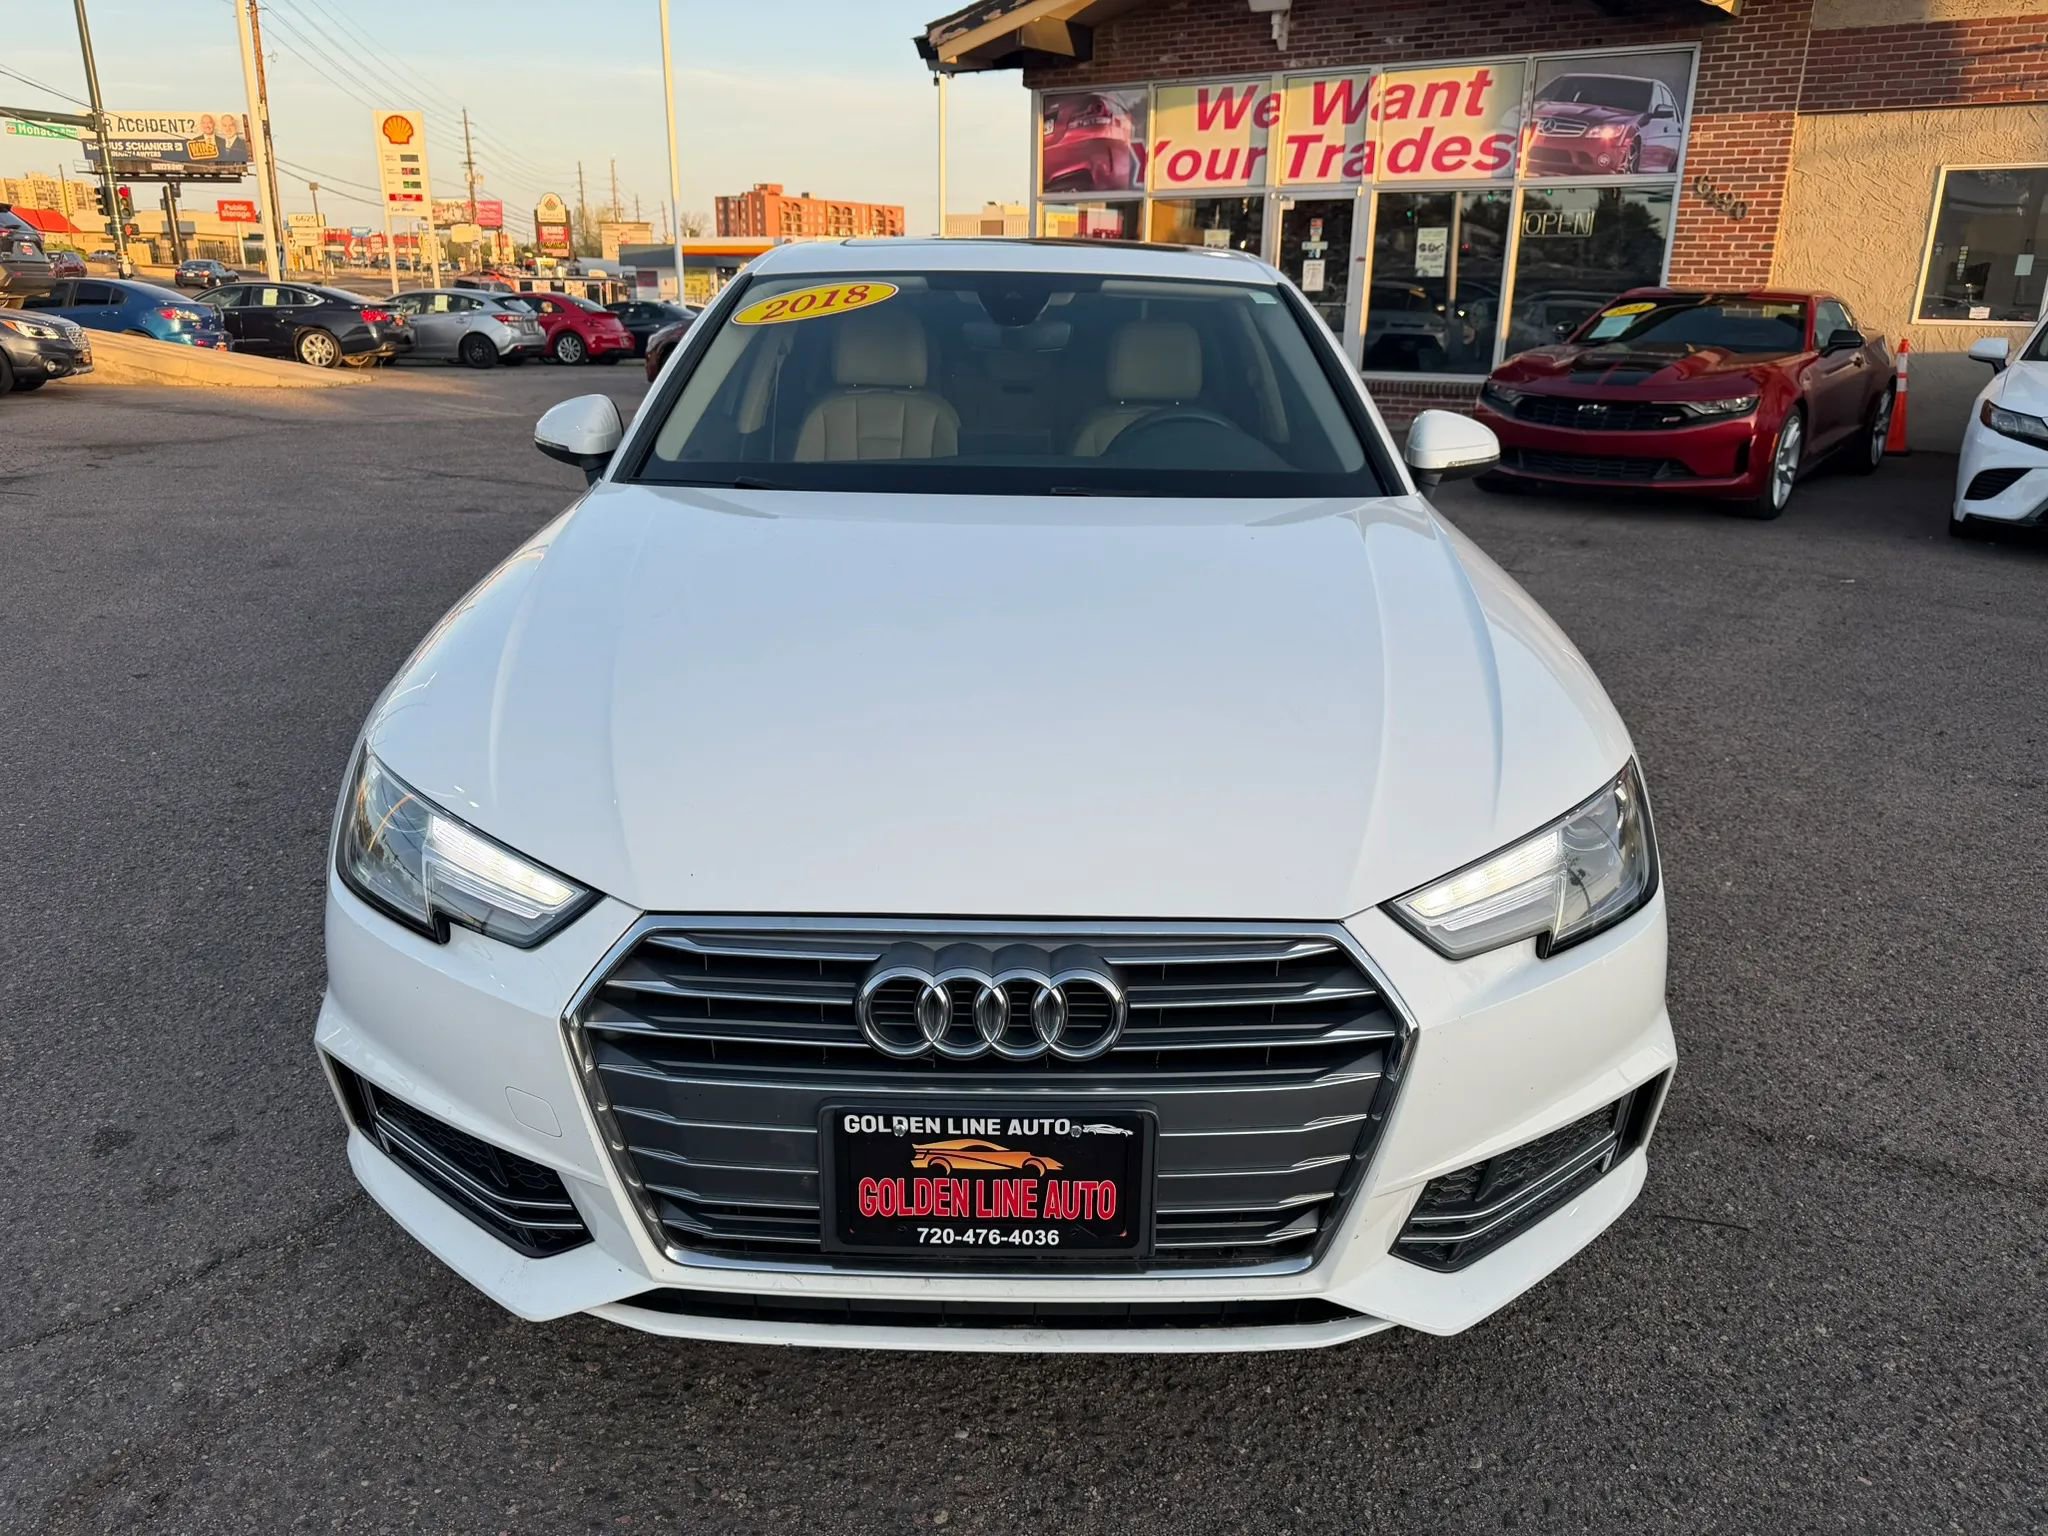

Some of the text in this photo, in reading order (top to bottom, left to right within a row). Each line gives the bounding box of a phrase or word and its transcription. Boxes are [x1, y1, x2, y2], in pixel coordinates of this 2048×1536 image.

[1198, 70, 1493, 131] We Want
[17, 124, 58, 137] Monaco
[117, 118, 195, 134] ACCIDENT?
[126, 142, 174, 152] SCHANKER
[1131, 140, 1268, 183] Your
[221, 210, 251, 219] Storage
[223, 203, 248, 211] Public
[1525, 211, 1590, 235] OPEN
[760, 285, 870, 321] 2018
[844, 1114, 1071, 1136] GOLDEN LINE AUTO
[858, 1176, 1117, 1221] GOLDEN LINE AUTO
[916, 1227, 1060, 1246] 720-476-4036
